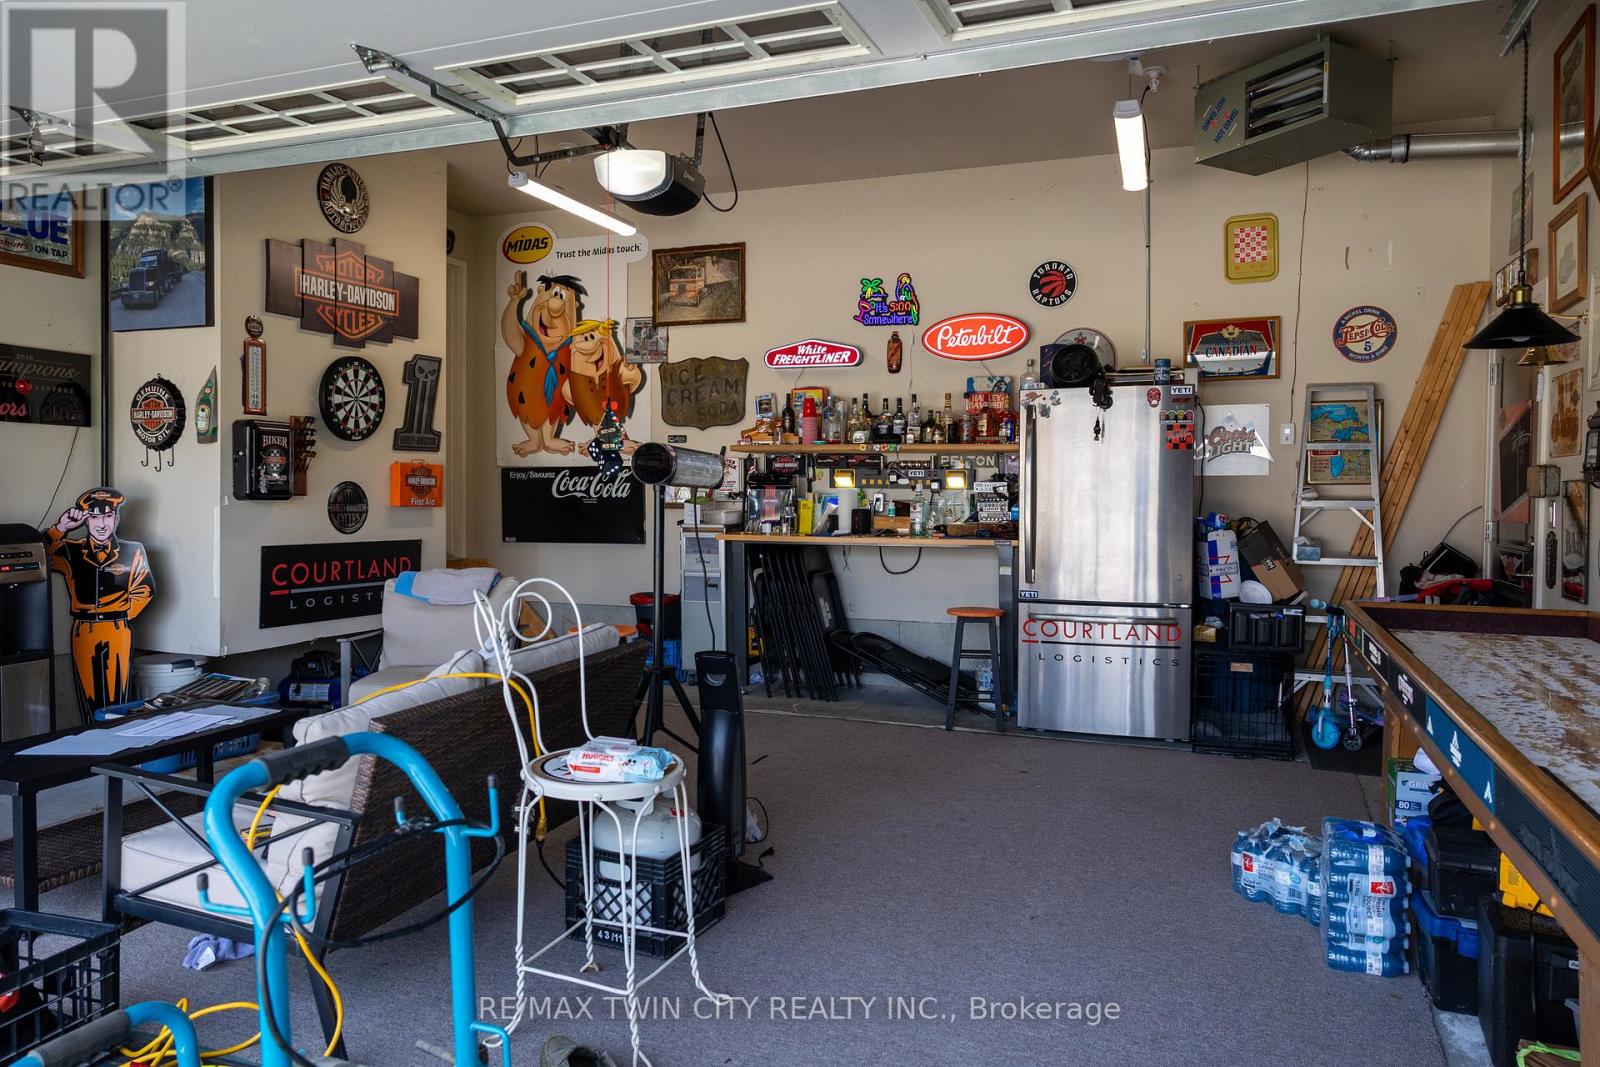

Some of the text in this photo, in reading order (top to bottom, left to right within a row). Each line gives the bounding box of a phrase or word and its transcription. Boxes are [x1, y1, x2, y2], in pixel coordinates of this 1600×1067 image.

[34, 244, 49, 255] ON
[50, 248, 68, 259] TAP
[507, 234, 549, 253] MIDAS
[556, 250, 577, 259] Trust
[578, 248, 591, 257] the
[592, 246, 615, 256] Midas
[324, 260, 377, 285] MOTOR
[1033, 262, 1074, 280] TORONTO
[301, 273, 396, 312] HARLEY-DAVIDSON
[1032, 288, 1072, 306] RAPTORS
[875, 301, 911, 313] It's 5:00
[324, 305, 376, 335] CYCLES
[863, 313, 913, 326] Somewhere
[936, 324, 1019, 350] Peterbilt
[772, 350, 852, 365] FREIGHTLINER
[797, 344, 828, 354] White
[1205, 344, 1257, 358] CANADIAN
[669, 364, 706, 387] ICE
[136, 385, 170, 401] GENUINE
[667, 378, 739, 406] CREAM
[697, 401, 739, 418] SODA
[136, 428, 171, 443] MOTOR OIL
[262, 435, 289, 448] BIKER
[1207, 425, 1257, 447] Coors
[551, 469, 632, 499] Coca-Cola
[411, 497, 424, 506] First
[271, 557, 412, 587] COURTLAND
[289, 592, 385, 610] LOGISTI
[1023, 619, 1182, 642] COURTLAND
[1038, 653, 1180, 667] LOGISTICS
[582, 752, 615, 762] HUGGIES
[1398, 801, 1410, 809] 80
